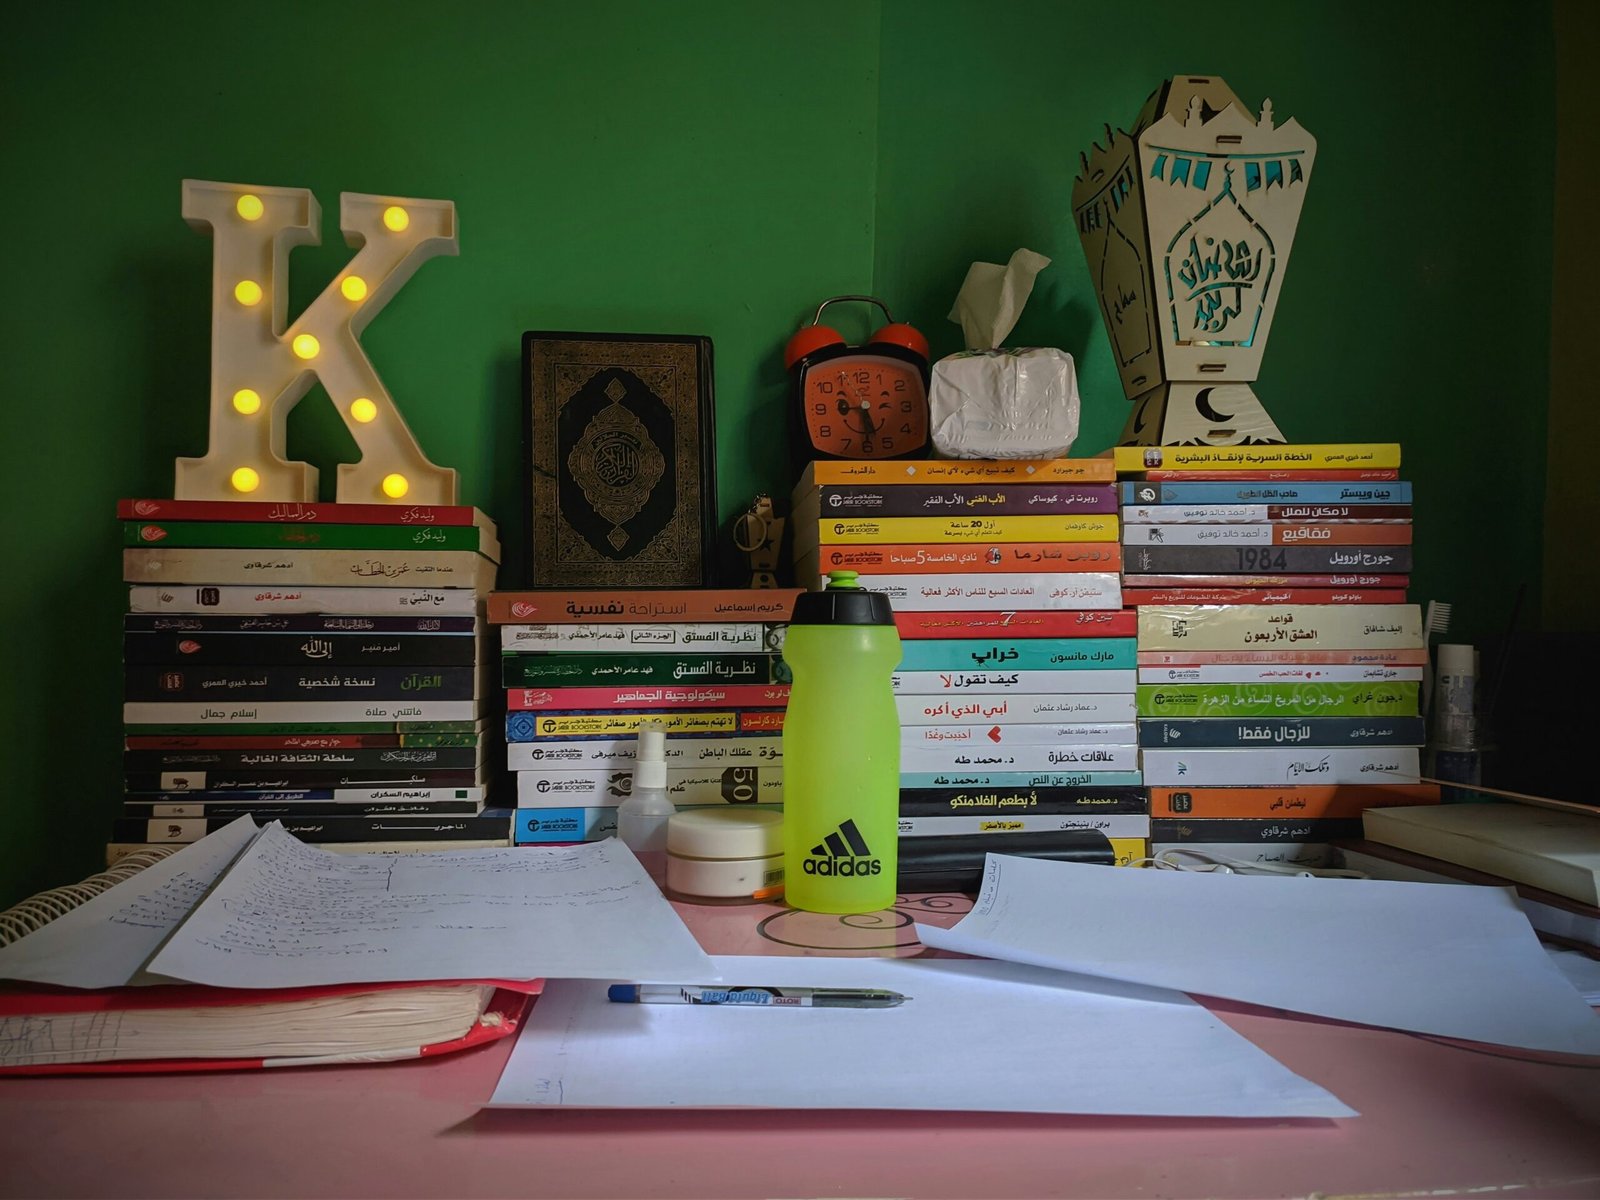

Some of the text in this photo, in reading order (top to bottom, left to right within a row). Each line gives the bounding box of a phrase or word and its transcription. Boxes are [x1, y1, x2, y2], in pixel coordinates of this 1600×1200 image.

[1177, 236, 1262, 288] رمضان
[1185, 282, 1252, 332] كريم
[175, 178, 461, 506] K
[852, 371, 870, 384] 12
[876, 374, 882, 386] 1
[816, 381, 833, 393] 10
[894, 380, 905, 391] 2
[815, 403, 826, 415] 9
[901, 401, 912, 413] 3
[820, 425, 831, 437] 8
[900, 423, 911, 434] 4
[841, 438, 852, 450] 7
[862, 440, 873, 453] 6
[882, 437, 894, 449] 5
[1175, 454, 1210, 465] البشرية
[1219, 453, 1242, 464] لإنقاذ
[1246, 453, 1281, 464] السرية
[1284, 453, 1312, 462] الخطة
[1324, 454, 1345, 463] العمري
[1345, 454, 1359, 463] خيري
[1028, 494, 1098, 505] روبرت كيوساكي
[1262, 489, 1298, 499] صاحب الظل
[1340, 488, 1391, 500] جين ويبستر
[923, 493, 1006, 508] الأب الغني الأب الفقير
[400, 506, 435, 523] وليد فكري
[1183, 508, 1247, 518] أحمد خالد توفيق
[1281, 507, 1349, 517] لا مكان للملل
[950, 520, 996, 529] أول 20 ساعة
[412, 528, 447, 544] وليد فكري
[1197, 528, 1260, 540] أحمد خالد توفيق
[1282, 527, 1331, 543] فقاقيع
[890, 550, 977, 565] نادي الخامسة 5 صباحا
[1235, 547, 1288, 570] 1984
[1329, 549, 1394, 566] جورج أورويل
[436, 565, 454, 573] عندما
[1329, 574, 1381, 585] جورج أورويل
[920, 587, 1035, 599] العادات السبع للناس الأكثر فعالية
[566, 600, 624, 618] نفسية
[629, 601, 687, 617] استراحة
[715, 603, 784, 613] كريم اسماعيل
[1000, 611, 1017, 627] 7
[1268, 613, 1293, 624] قواعد
[598, 632, 613, 640] عامر
[634, 632, 653, 640] الثاني
[1244, 627, 1318, 643] العشق الأربعون
[1363, 625, 1403, 635] إليف شافاق
[682, 631, 757, 644] نظرية الفستق
[1050, 651, 1114, 664] مارك مانسون
[622, 665, 654, 675] فهد عامر
[673, 660, 756, 680] نظرية الفستق
[1259, 670, 1277, 678] الخمس
[1384, 669, 1397, 678] جاري
[202, 676, 267, 689] أحمد خيري العمري
[298, 676, 376, 689] نسخة شخصية
[400, 673, 442, 691] القرآن
[940, 673, 1019, 688] كيف تقول لا
[613, 689, 725, 703] سيكولوجية الجماهير
[1202, 694, 1344, 707] الرجال من المريخ النساء من الزهرة
[1353, 691, 1373, 704] غراي
[201, 709, 257, 720] إسلام جمال
[365, 707, 422, 719] فاتتني صلاة
[924, 700, 1007, 719] أبي الذي أكره
[1033, 703, 1091, 714] عماد رشاد عثمان
[604, 717, 733, 730] لا تهتم بصغائر الأمور صغائر
[1238, 726, 1271, 740] فقط!
[280, 753, 355, 764] سلطة الثقافة
[699, 748, 753, 760] عقلك الباطن
[954, 755, 970, 764] طه
[1048, 751, 1114, 765] علاقات خطرة
[732, 767, 754, 801] 50
[934, 776, 949, 785] طه
[1028, 774, 1092, 788] الخروج عن النص
[370, 790, 431, 799] إبراهيم السكران
[670, 785, 686, 794] علم
[949, 793, 1028, 809] بطعم الفلامنكو
[1270, 797, 1283, 811] قلبي
[1261, 826, 1288, 839] شرقاوي
[803, 856, 881, 876] adidas
[702, 990, 769, 1004] Liquid Ball
[775, 997, 800, 1005] ROTO
